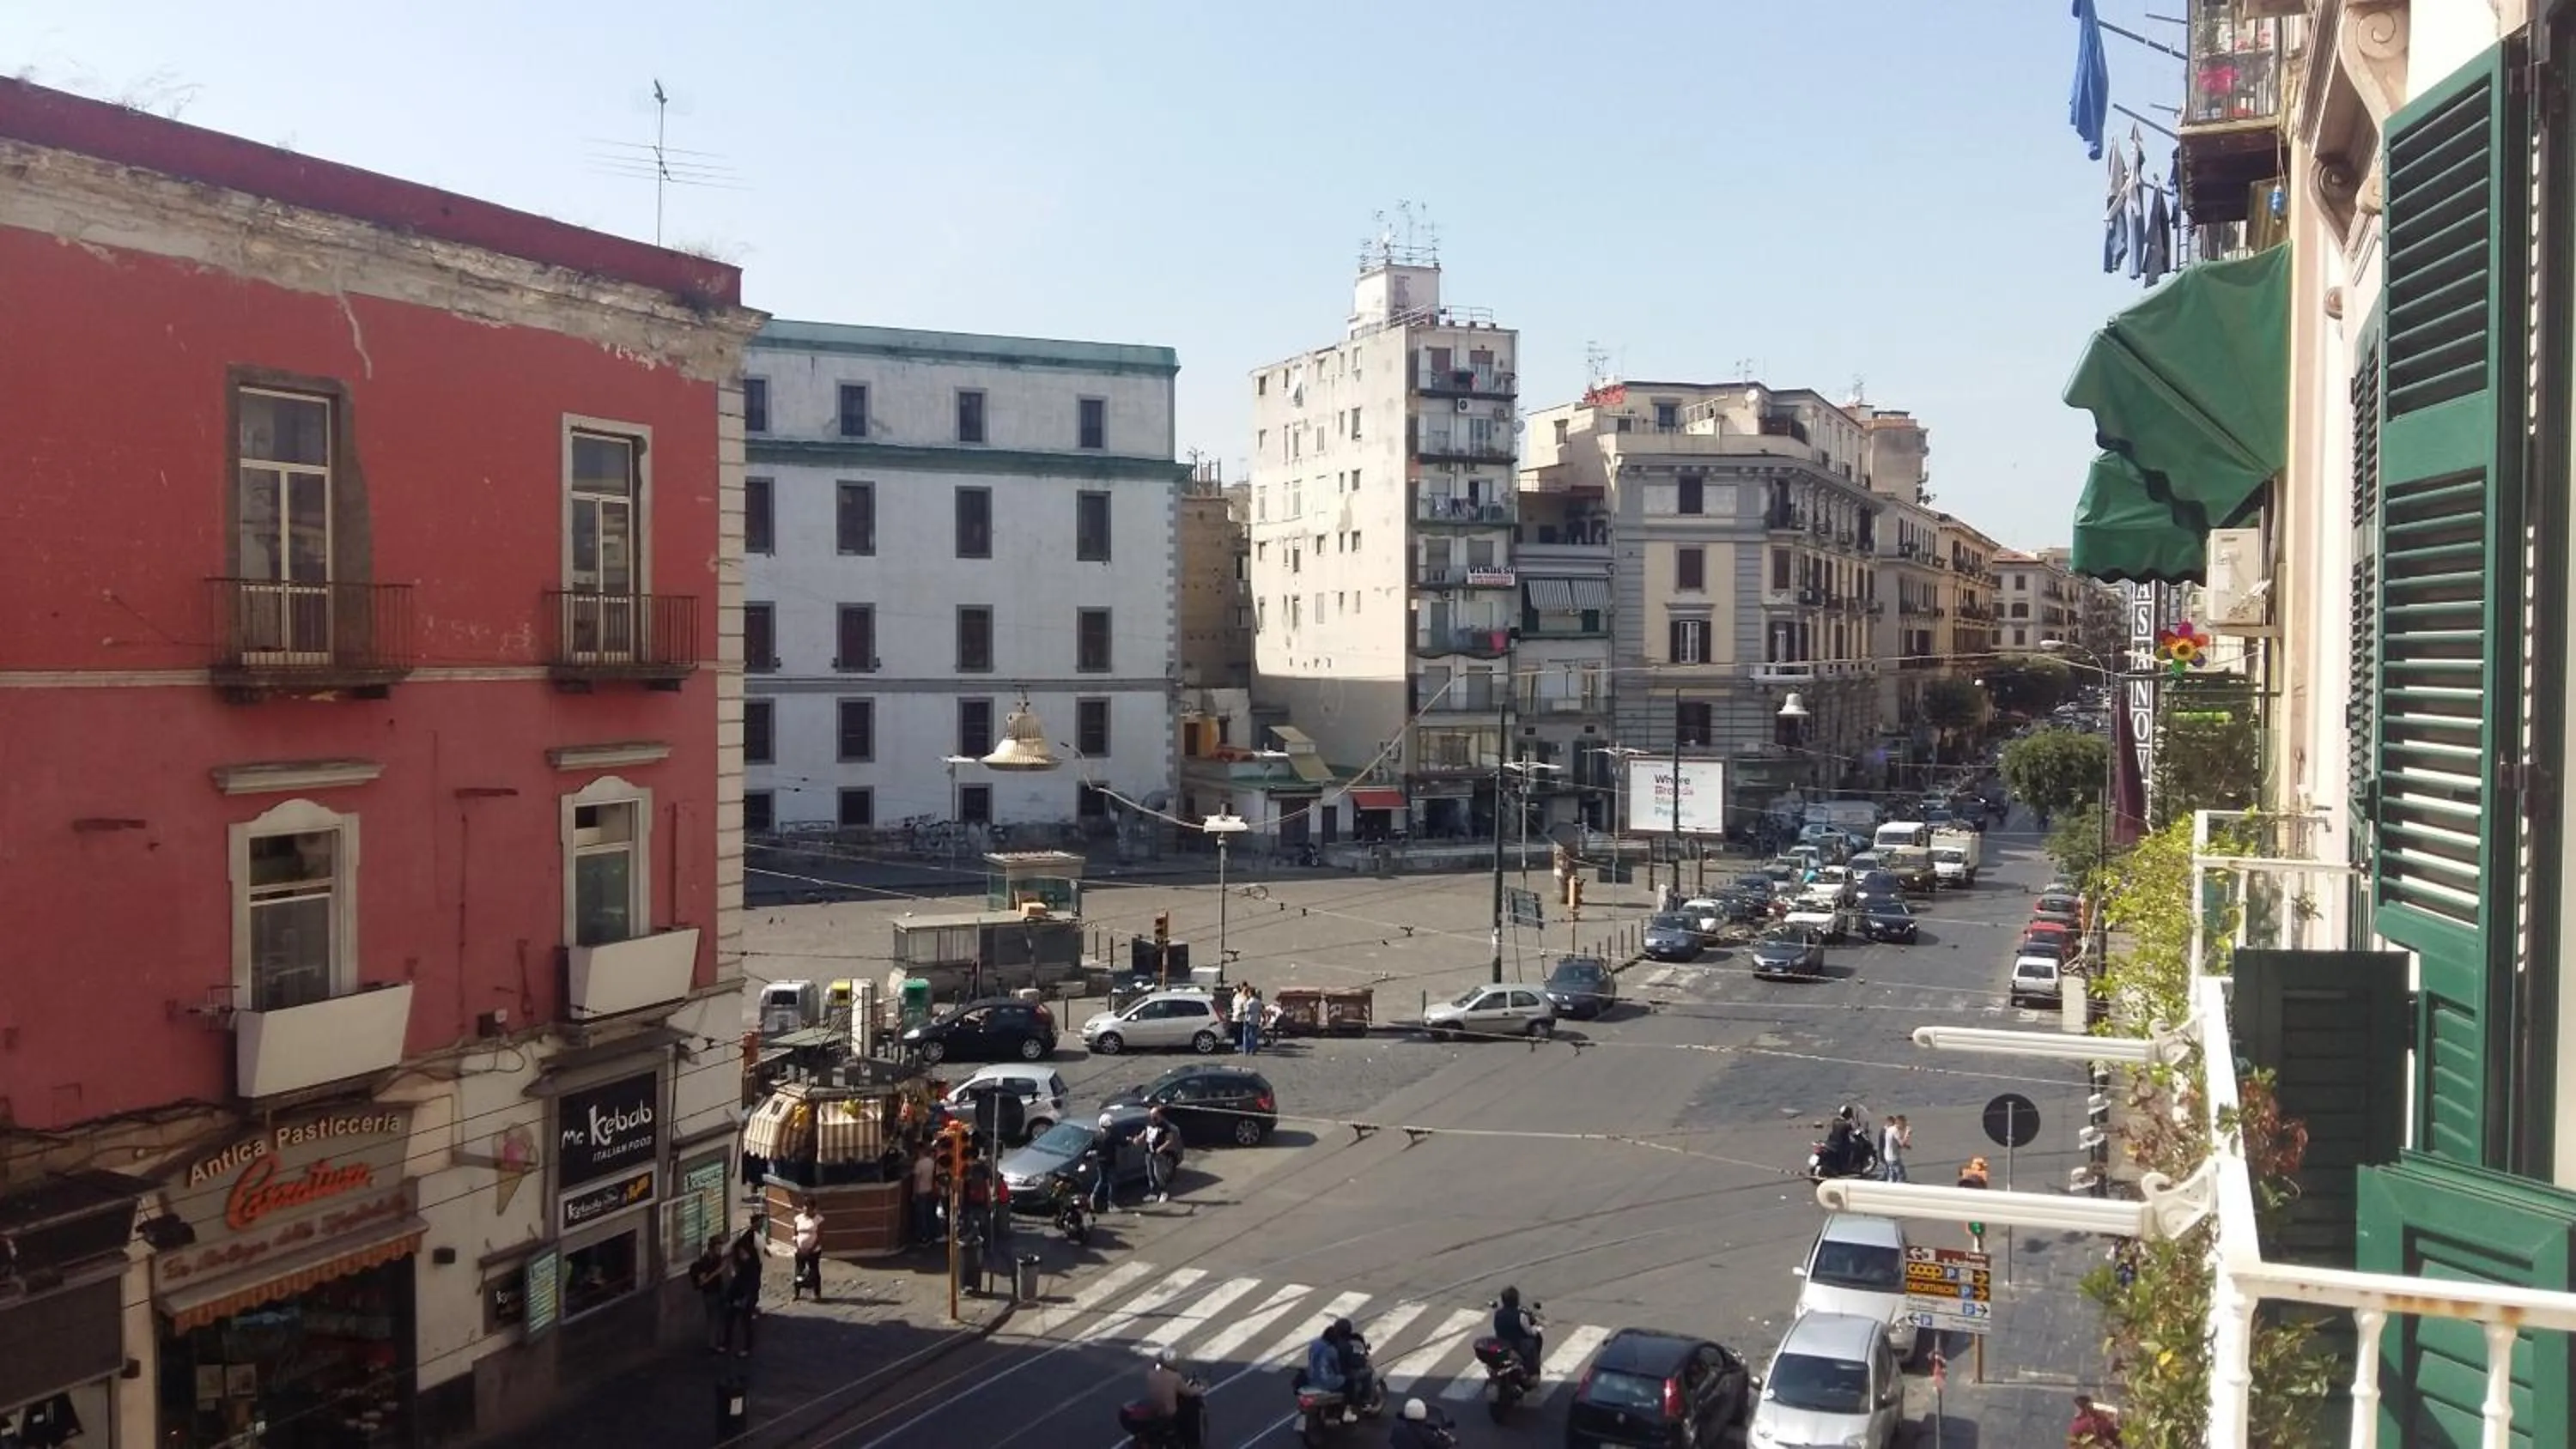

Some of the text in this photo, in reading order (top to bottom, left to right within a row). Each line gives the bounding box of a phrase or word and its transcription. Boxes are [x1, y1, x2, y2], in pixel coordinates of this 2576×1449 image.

[2133, 583, 2152, 774] ASANOV
[1656, 774, 1691, 785] Whre
[188, 1113, 402, 1188] Antica Pasticceria
[562, 1099, 653, 1149] Mc Kebab
